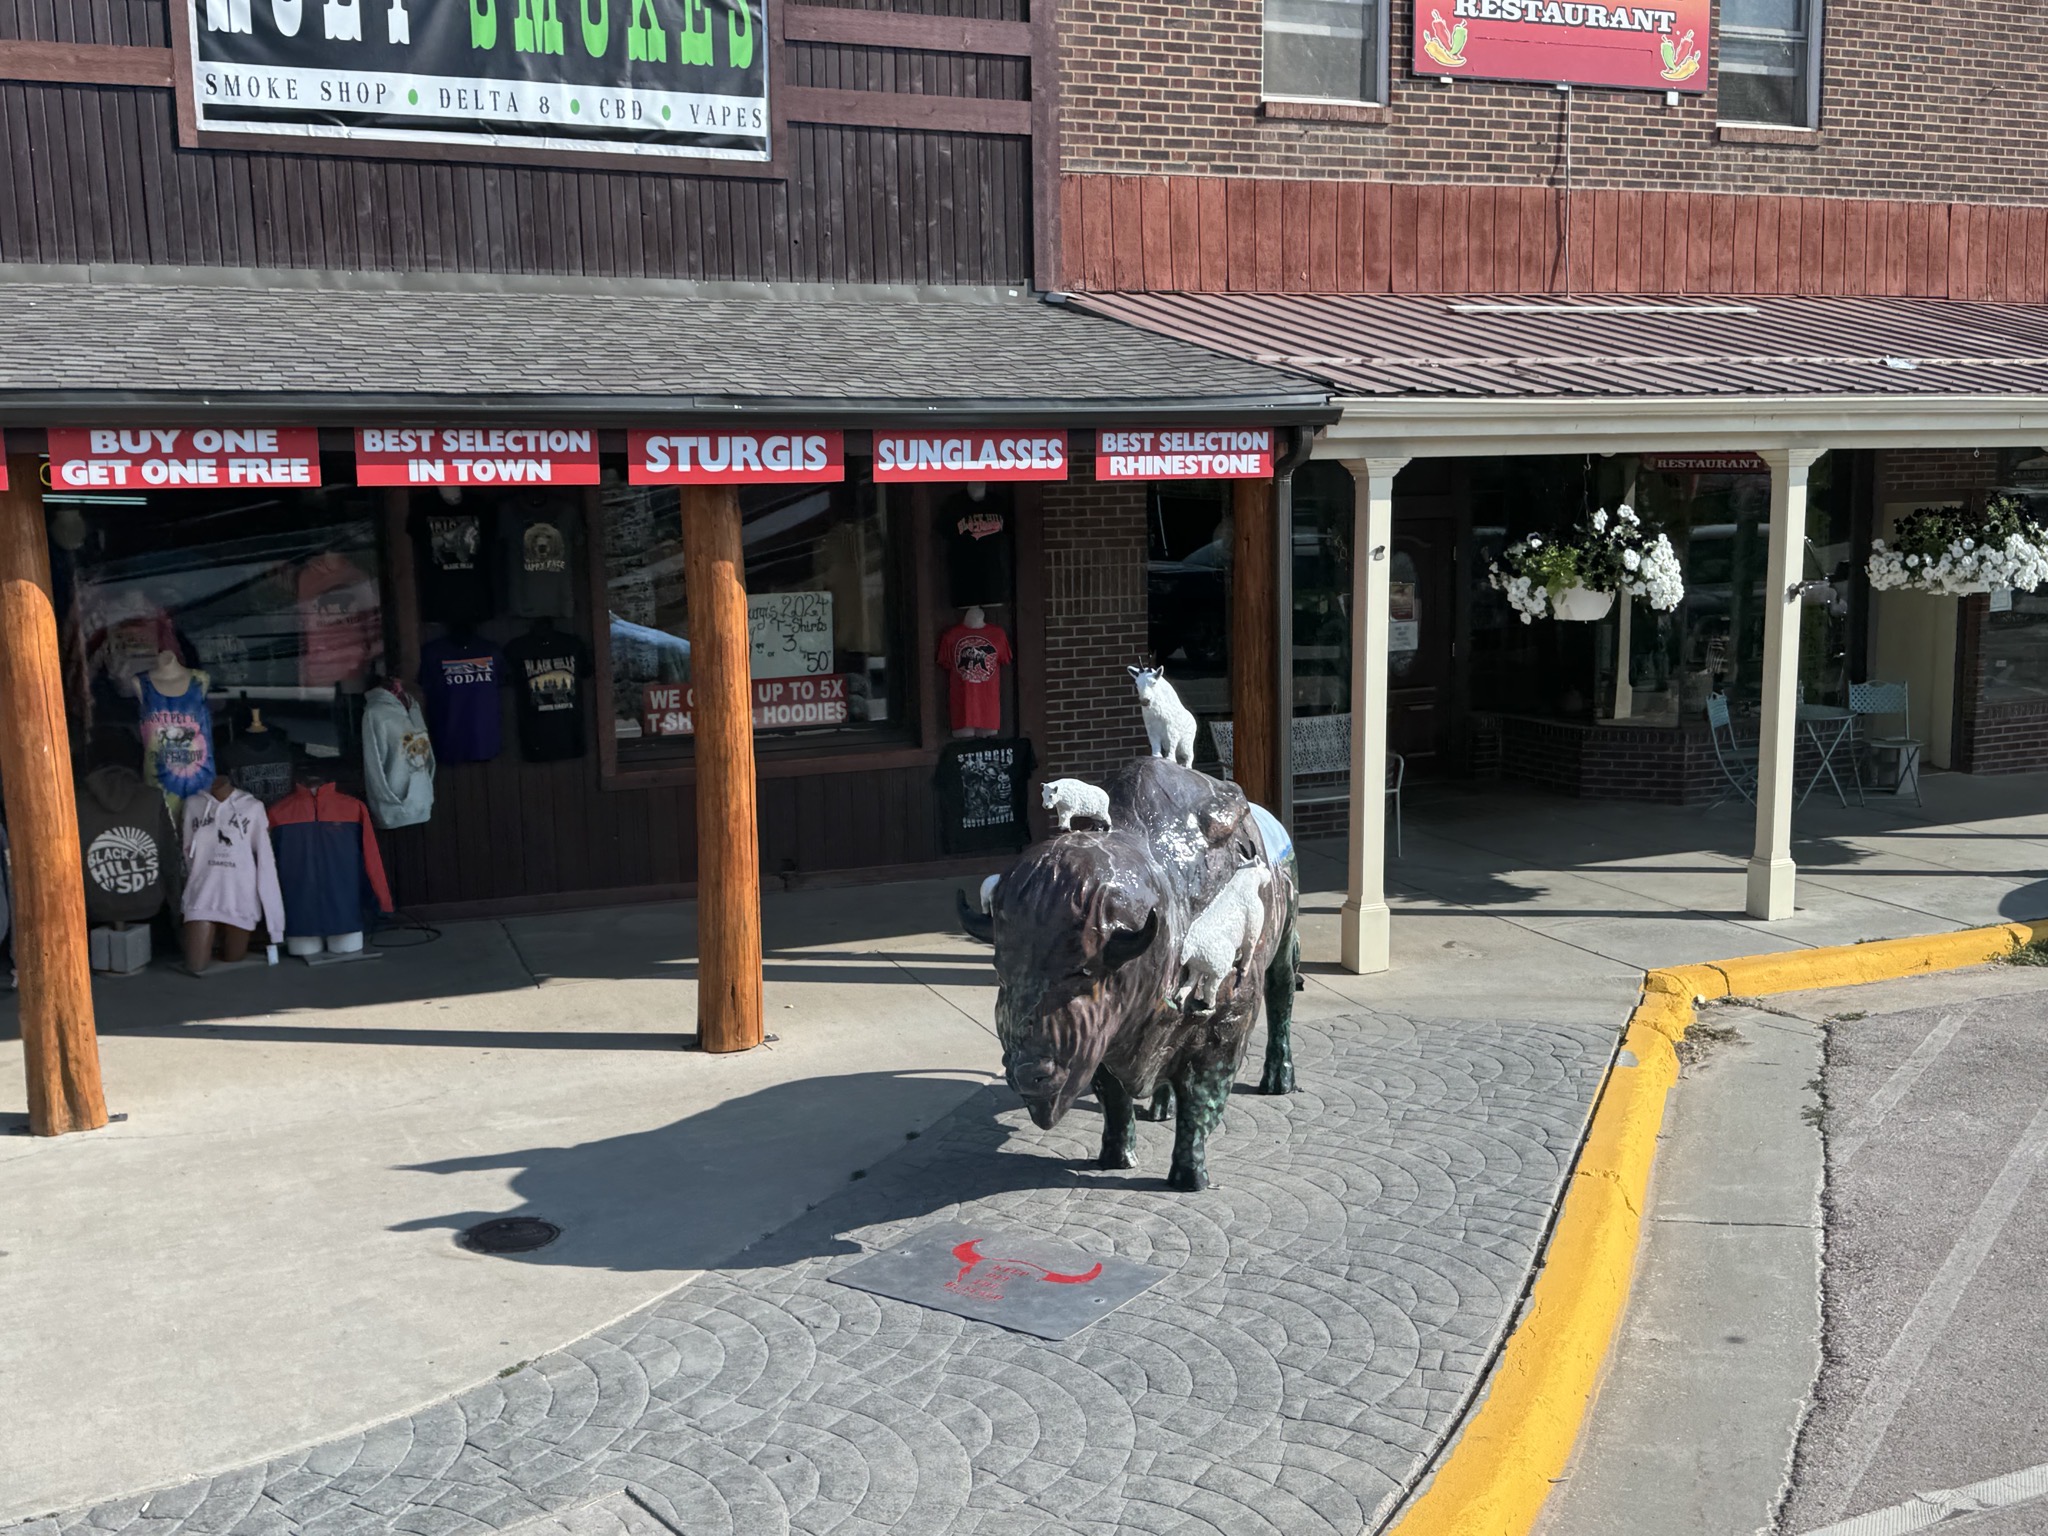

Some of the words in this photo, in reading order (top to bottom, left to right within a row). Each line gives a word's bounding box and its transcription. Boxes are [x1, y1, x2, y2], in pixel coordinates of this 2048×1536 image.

[1453, 0, 1676, 32] RESTAURANT
[205, 73, 298, 100] SMOKE
[320, 80, 387, 105] SHOP
[439, 87, 519, 113] DELTA
[539, 96, 550, 115] 8
[600, 98, 643, 121] CBD
[689, 103, 763, 129] VAPES
[90, 429, 182, 454] BUY
[192, 429, 279, 453] ONE
[363, 429, 436, 453] BEST
[442, 429, 591, 453] SELECTION
[1102, 432, 1155, 453] BEST
[1159, 431, 1269, 452] SELECTION
[645, 435, 828, 473] STURGIS
[877, 438, 1063, 471] SUNGLASSES
[1110, 454, 1261, 476] RHINESTONE
[1657, 459, 1762, 469] RESTAURANT
[61, 459, 132, 486] GET
[141, 458, 218, 485] ONE
[228, 458, 311, 484] FREE
[408, 459, 445, 483] IN
[452, 459, 552, 482] TOWN
[780, 592, 829, 618] 2024
[782, 634, 797, 652] 3
[446, 672, 492, 685] SODAK
[650, 689, 680, 710] WE
[757, 682, 784, 703] UP
[789, 681, 814, 700] TO
[819, 679, 844, 698] 5X
[763, 701, 847, 725] HOODIES
[957, 747, 1014, 765] STURGIS
[962, 816, 986, 829] SOUTH
[987, 811, 1014, 825] DAKOTA
[87, 848, 130, 870] BLACK
[90, 857, 159, 884] HILLS
[115, 873, 146, 894] SD
